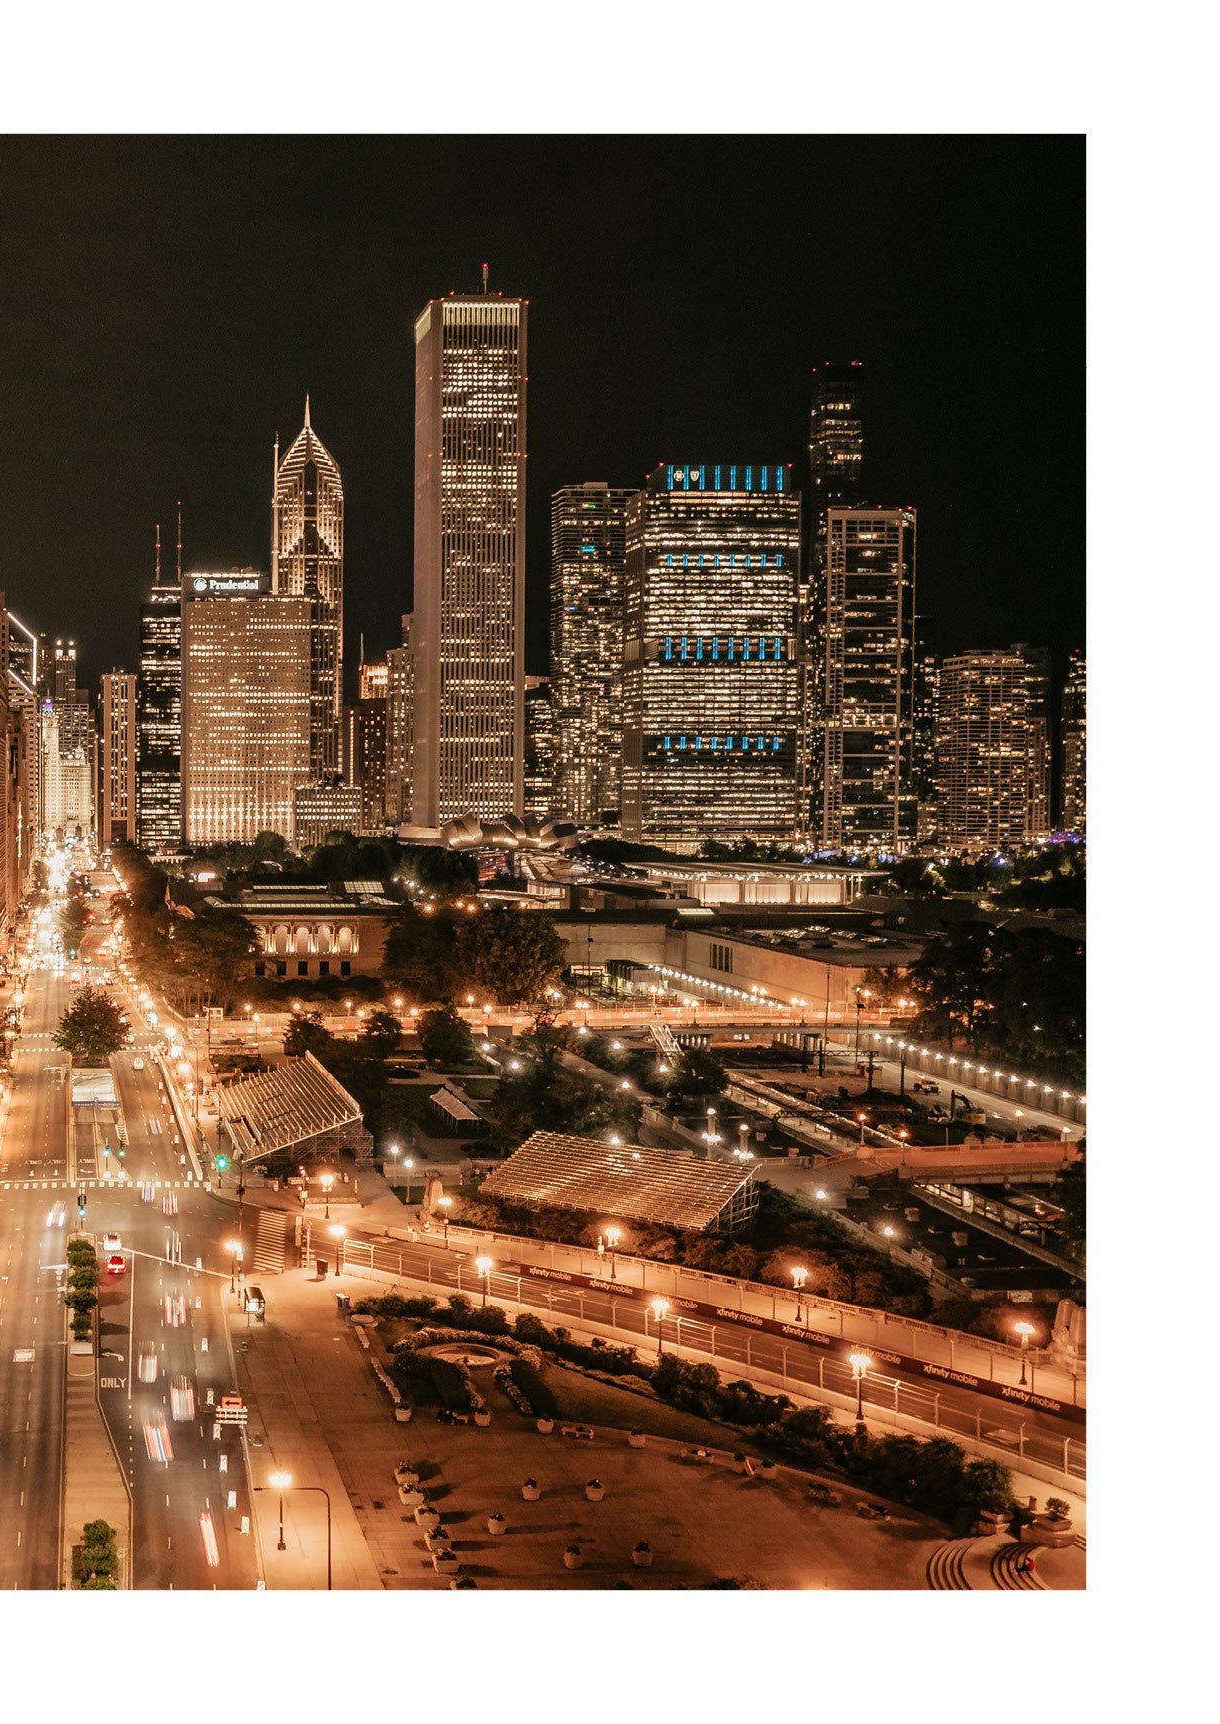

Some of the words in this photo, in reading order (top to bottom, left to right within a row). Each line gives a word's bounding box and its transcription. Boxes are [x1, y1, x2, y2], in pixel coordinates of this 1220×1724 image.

[209, 579, 259, 590] Prudential
[529, 1267, 550, 1282] xfinity
[550, 1271, 572, 1282] mobile
[589, 1279, 611, 1291] xfinity
[611, 1284, 633, 1295] mobile
[716, 1308, 739, 1320] xfinity
[739, 1313, 763, 1326] mobile
[782, 1324, 805, 1338] xfinity
[805, 1331, 830, 1344] mobile
[875, 1351, 901, 1365] mobile
[100, 1377, 127, 1389] ONLY
[923, 1364, 950, 1378] xfinity
[950, 1371, 978, 1387] mobile
[1002, 1387, 1030, 1401] xfinity
[1030, 1395, 1060, 1411] mobile
